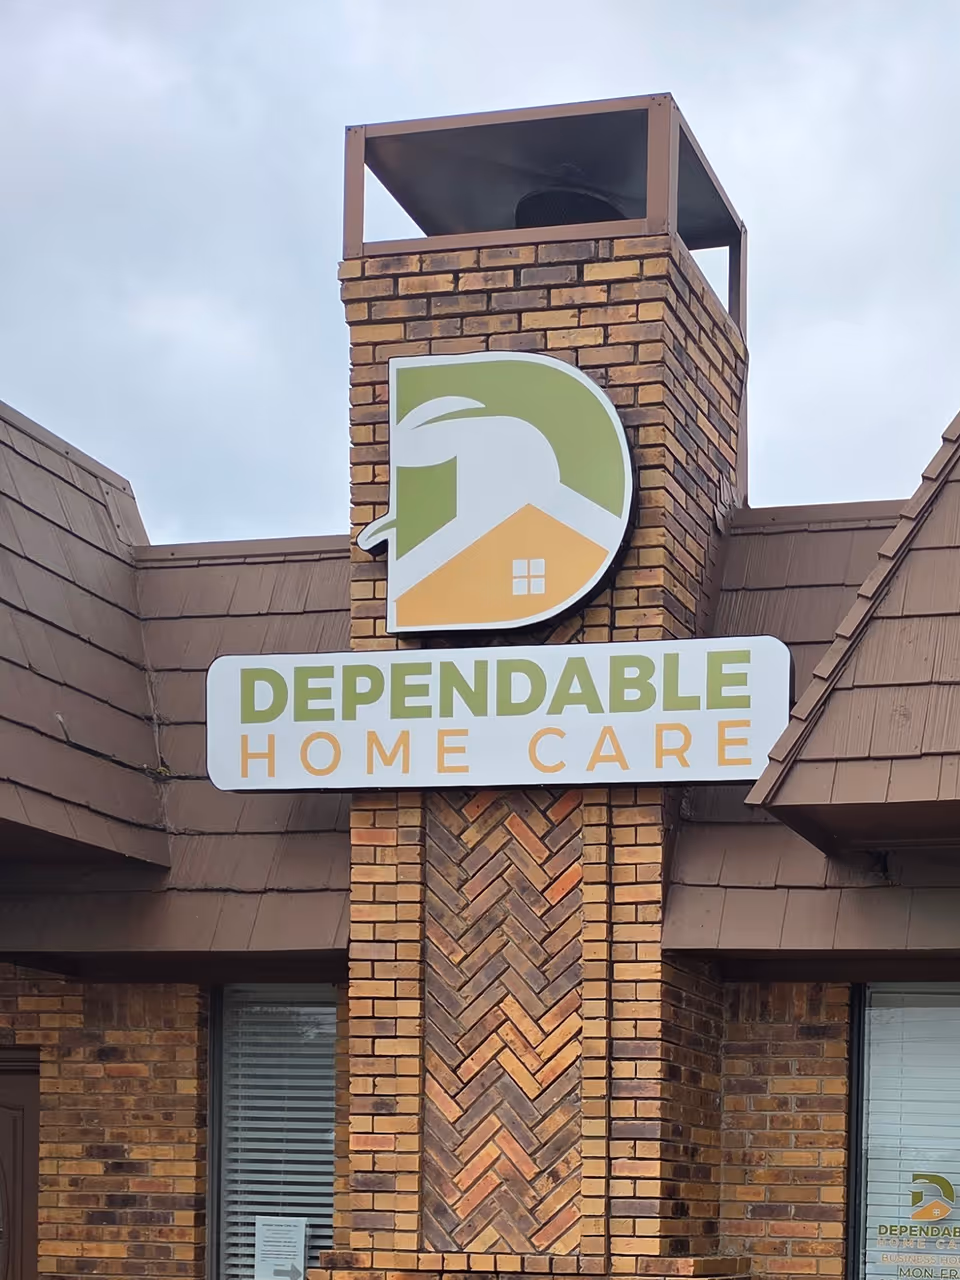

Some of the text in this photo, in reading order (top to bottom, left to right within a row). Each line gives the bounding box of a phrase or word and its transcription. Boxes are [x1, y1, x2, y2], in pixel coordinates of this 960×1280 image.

[239, 649, 752, 724] DEPENDABLE
[240, 719, 752, 778] HOME CARE
[877, 1238, 926, 1248] HOME
[882, 1254, 936, 1264] BUSINESS
